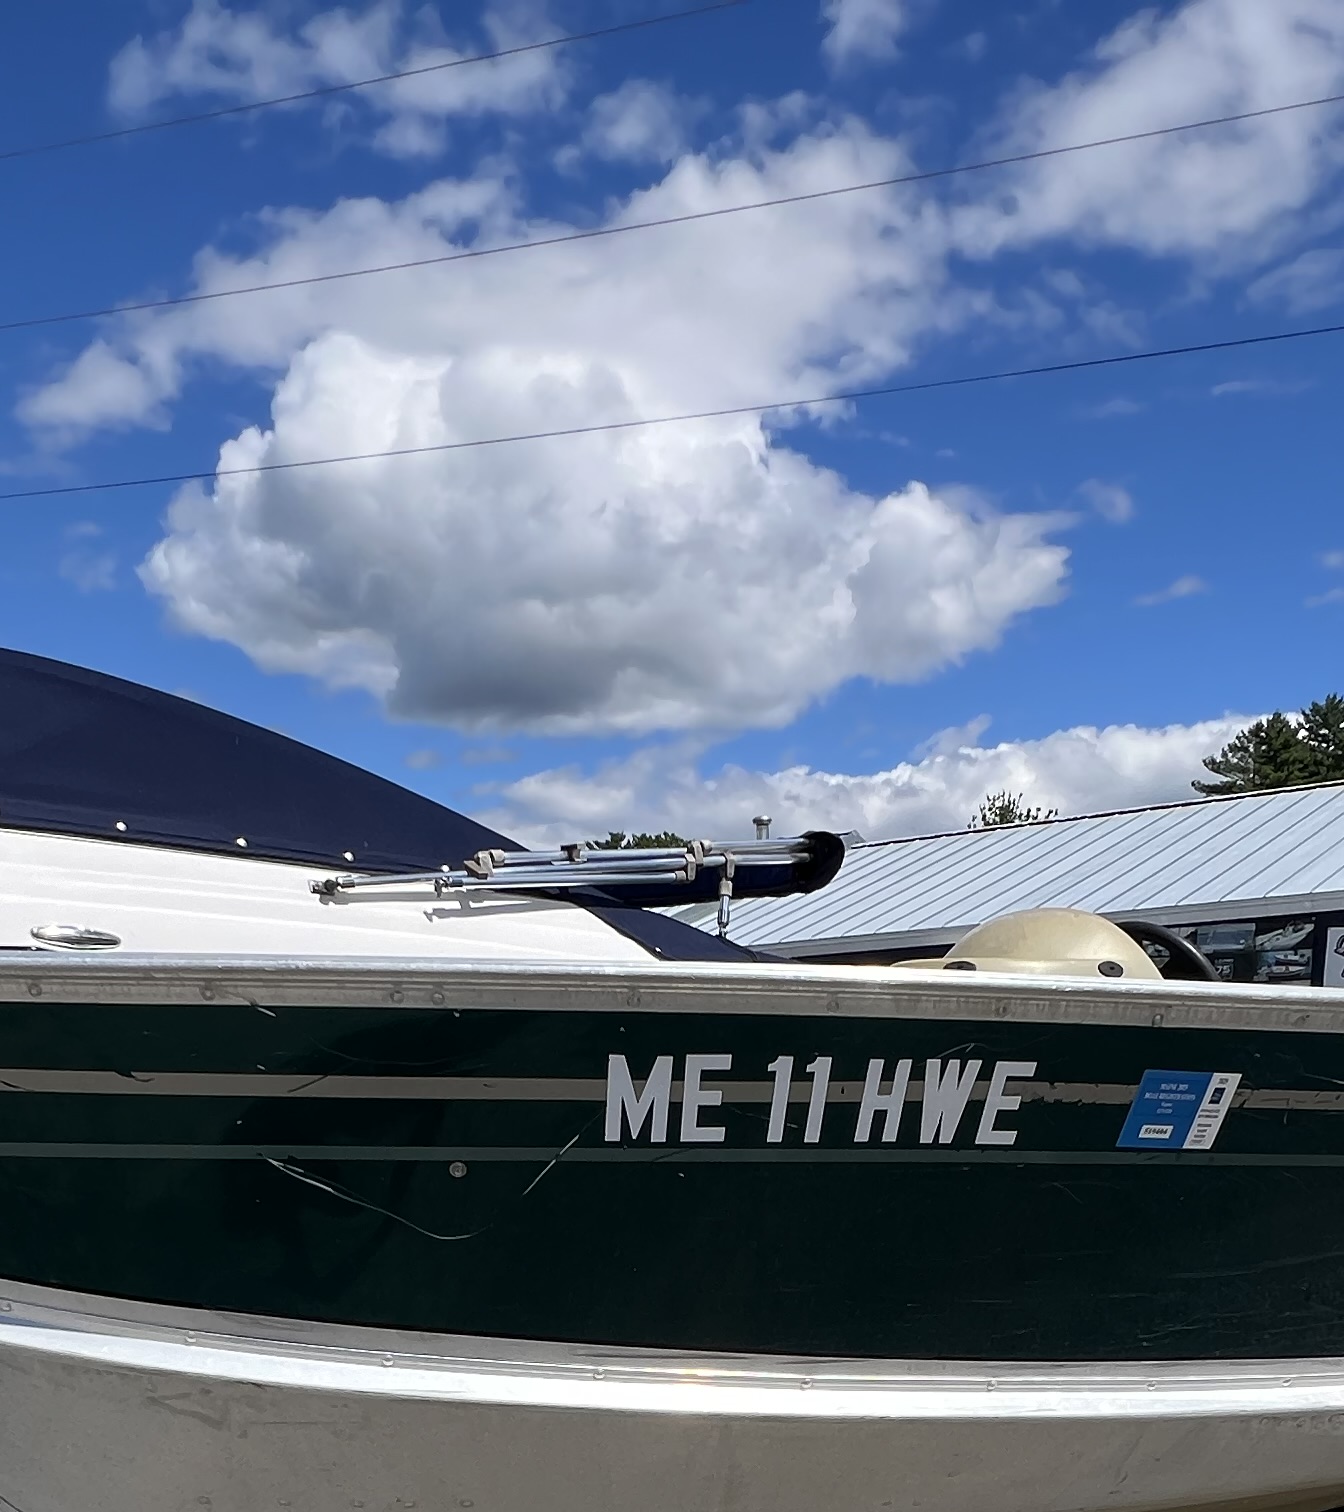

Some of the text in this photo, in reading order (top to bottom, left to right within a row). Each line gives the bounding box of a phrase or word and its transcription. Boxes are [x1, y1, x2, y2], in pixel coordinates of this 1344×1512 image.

[604, 1053, 1038, 1145] ME 11 HWE
